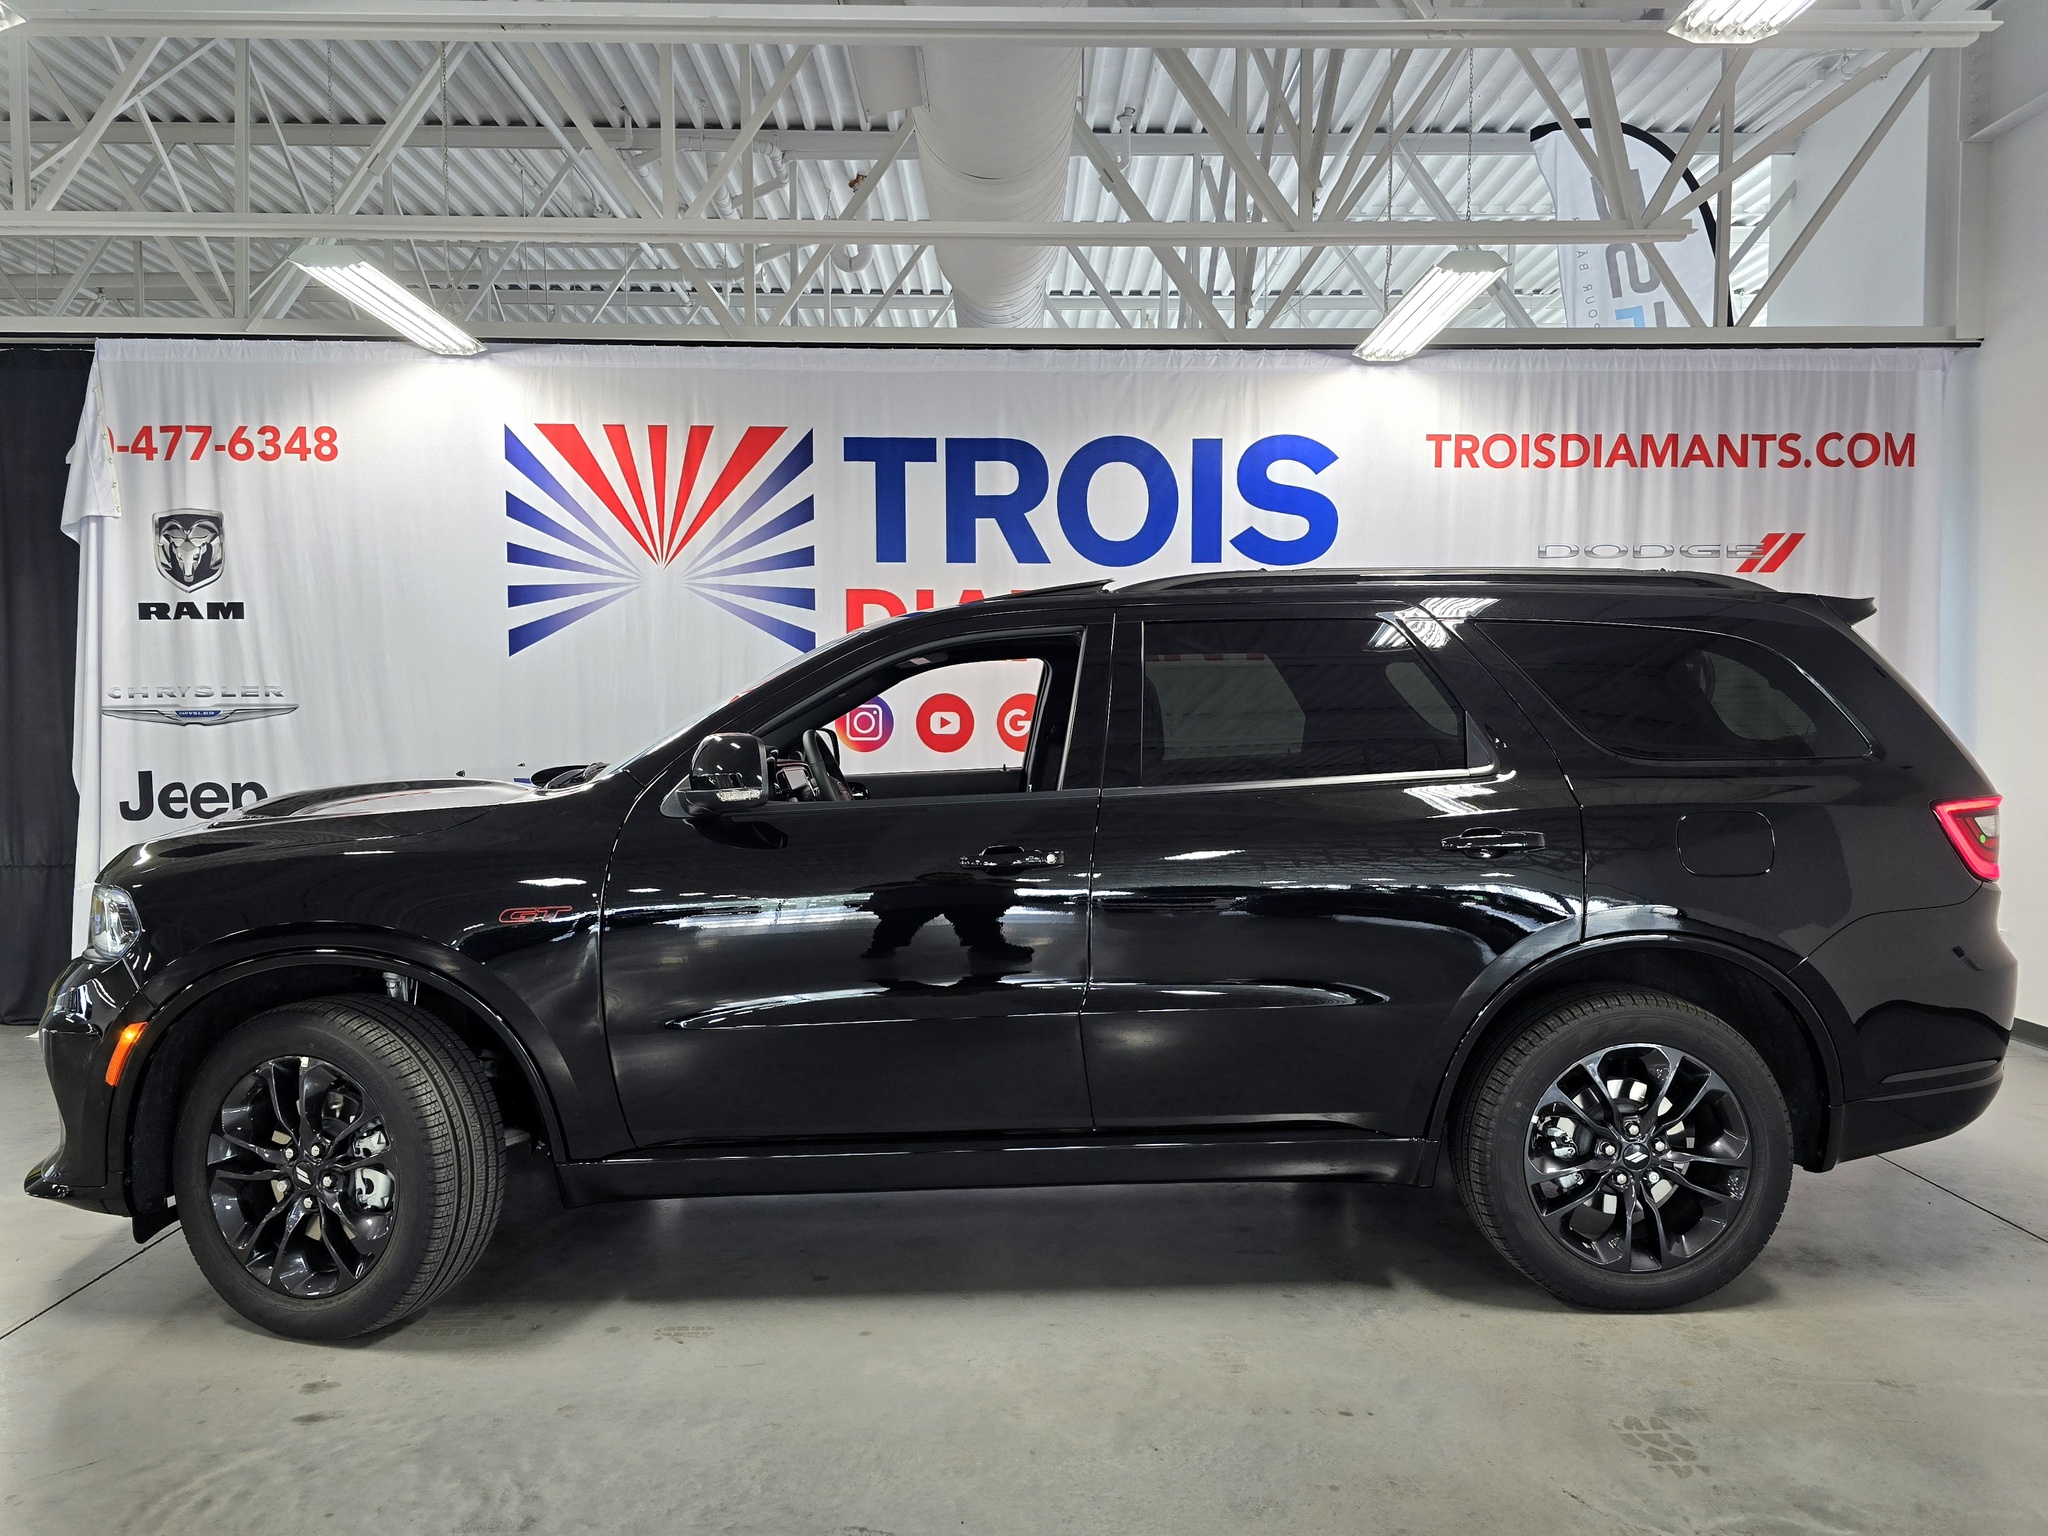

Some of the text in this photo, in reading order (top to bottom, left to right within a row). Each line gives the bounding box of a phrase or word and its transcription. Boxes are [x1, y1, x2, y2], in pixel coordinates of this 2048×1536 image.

[107, 425, 339, 462] -477-6348
[1426, 431, 1916, 470] TROISDIAMANTS.COM
[844, 433, 1339, 567] TROIS
[1538, 542, 1765, 559] DODGE
[138, 602, 245, 621] RAM
[107, 685, 285, 699] CHRYSLER
[499, 906, 573, 924] GT
